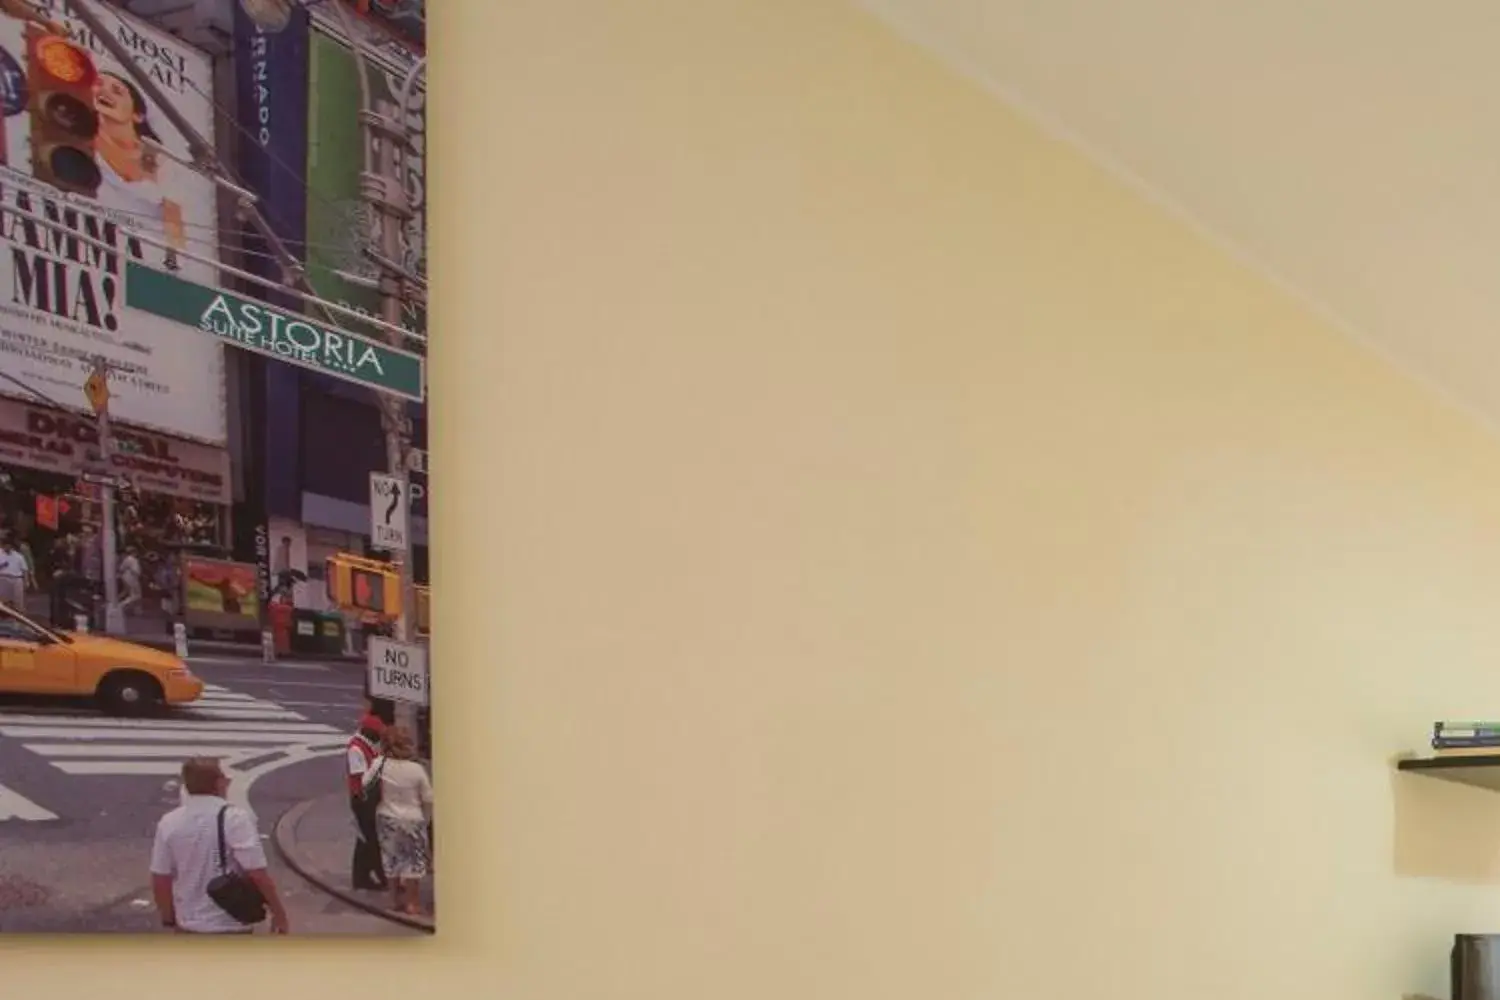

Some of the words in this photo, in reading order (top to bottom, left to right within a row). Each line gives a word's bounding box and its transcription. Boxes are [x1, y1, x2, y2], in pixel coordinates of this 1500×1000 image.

[117, 26, 186, 73] MOST
[11, 247, 118, 332] MIA!
[200, 294, 385, 377] ASTORIA
[260, 334, 322, 368] HOTEL
[384, 647, 409, 668] NO
[374, 665, 422, 691] TURNS
